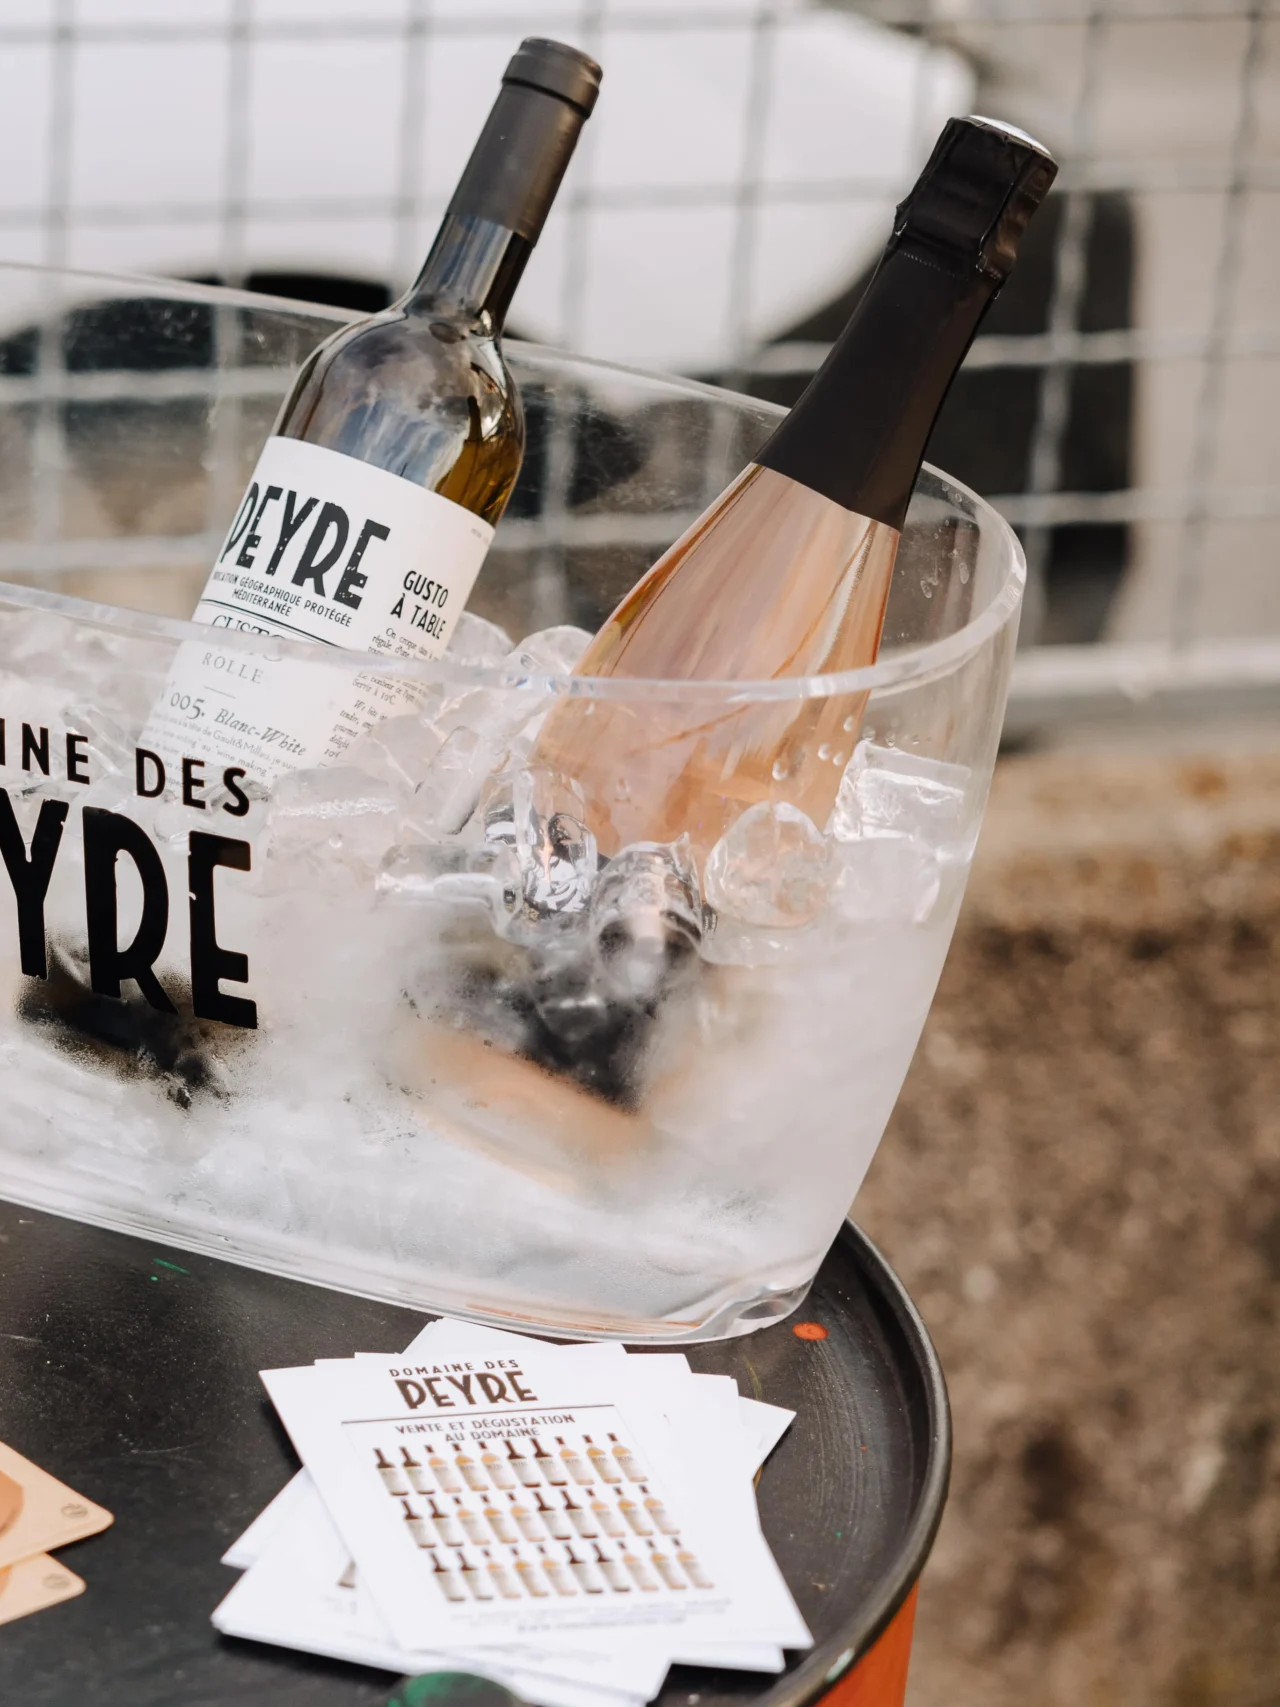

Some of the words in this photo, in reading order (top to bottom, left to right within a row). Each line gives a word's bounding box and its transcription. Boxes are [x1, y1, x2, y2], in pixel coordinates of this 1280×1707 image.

[221, 482, 391, 610] PEYRE
[232, 588, 293, 617] MÉDITERRANÉE
[239, 576, 303, 606] GÉOGRAPHIQUE
[304, 600, 353, 627] PROTÉGÉE
[403, 570, 449, 609] GUSTO
[390, 592, 406, 619] À
[410, 605, 446, 640] TABLE
[202, 652, 264, 684] ROLLE
[170, 692, 205, 720] 005.
[214, 708, 307, 756] Blanc-White
[135, 747, 250, 817] DES
[389, 1362, 475, 1377] DOMAINE
[484, 1359, 519, 1370] DES
[394, 1370, 538, 1409] PEYRE
[395, 1421, 445, 1434] VENTE
[448, 1420, 465, 1431] ET
[472, 1414, 576, 1429] DÉGUSTATION
[445, 1432, 465, 1442] AU
[470, 1427, 540, 1441] DOMAINE
